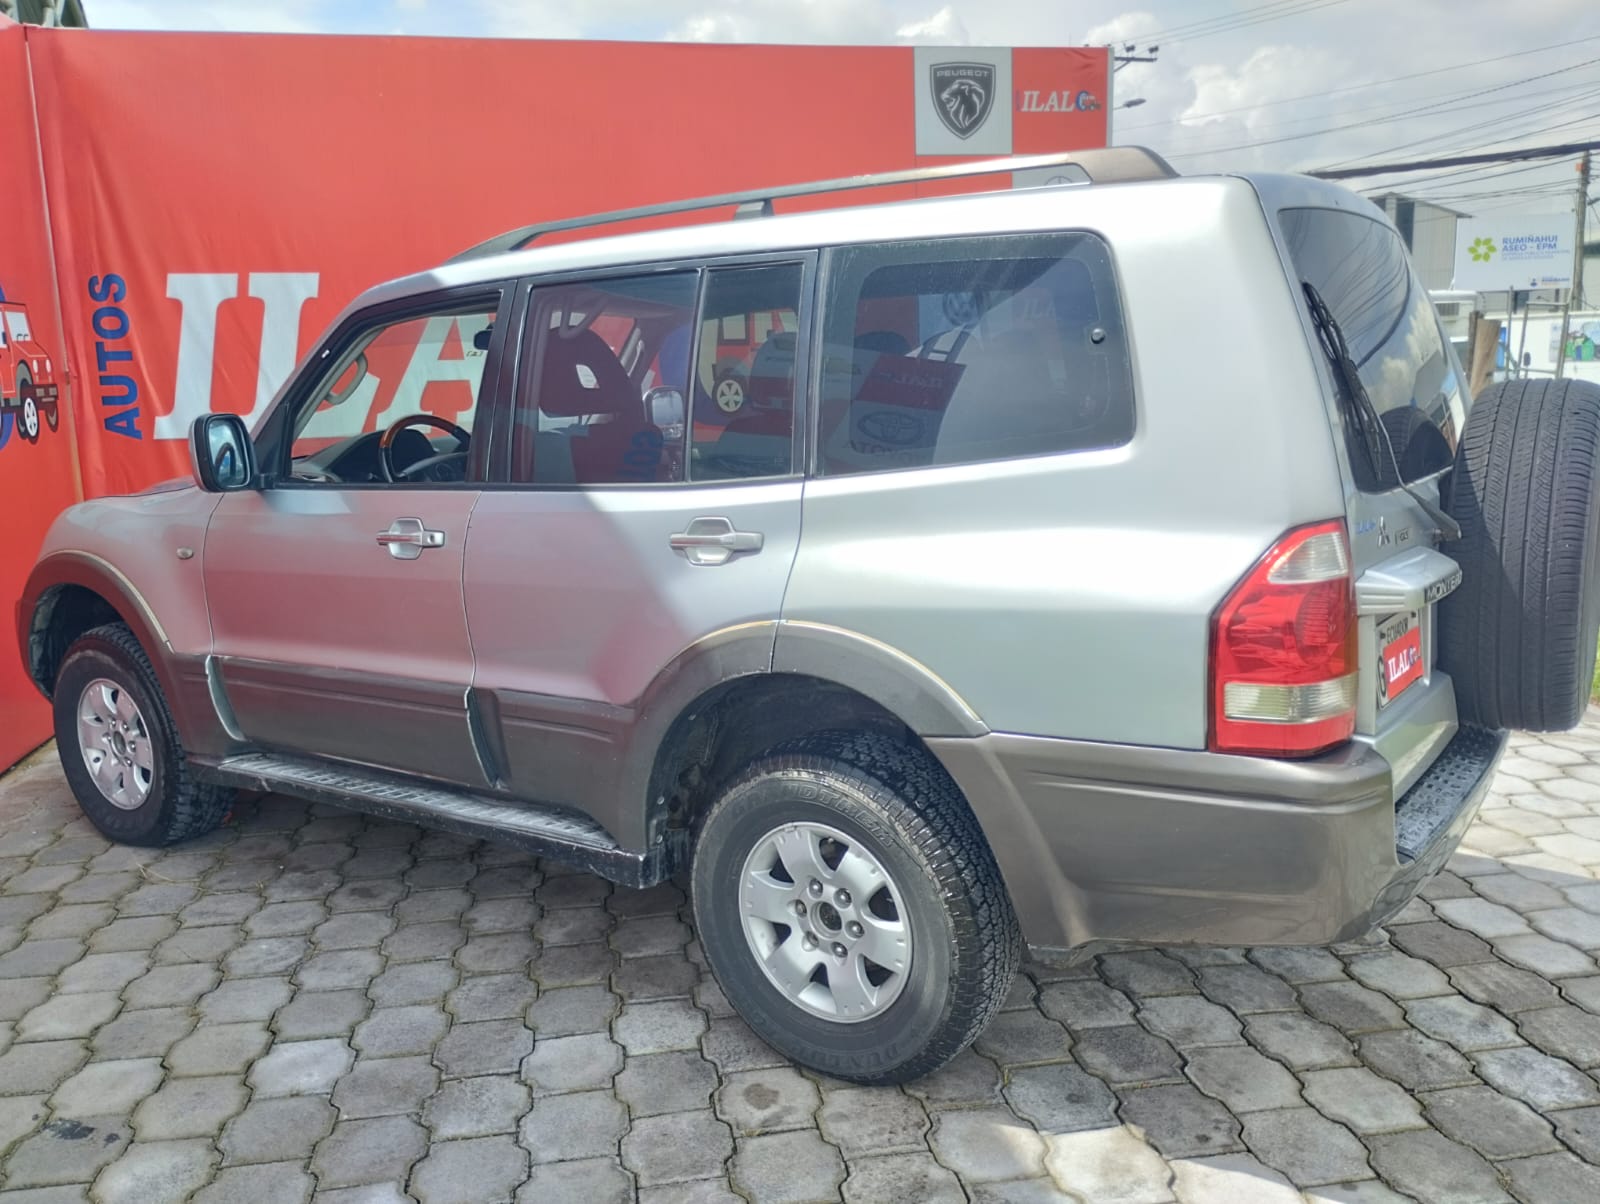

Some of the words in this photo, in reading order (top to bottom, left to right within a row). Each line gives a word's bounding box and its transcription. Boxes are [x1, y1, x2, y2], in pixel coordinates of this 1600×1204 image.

[936, 69, 990, 77] PEUGEOT
[1503, 234, 1558, 245] RUMIÑAHUI
[1503, 243, 1527, 252] ASEO
[1537, 241, 1557, 250] EPM
[88, 274, 142, 440] AUTOS
